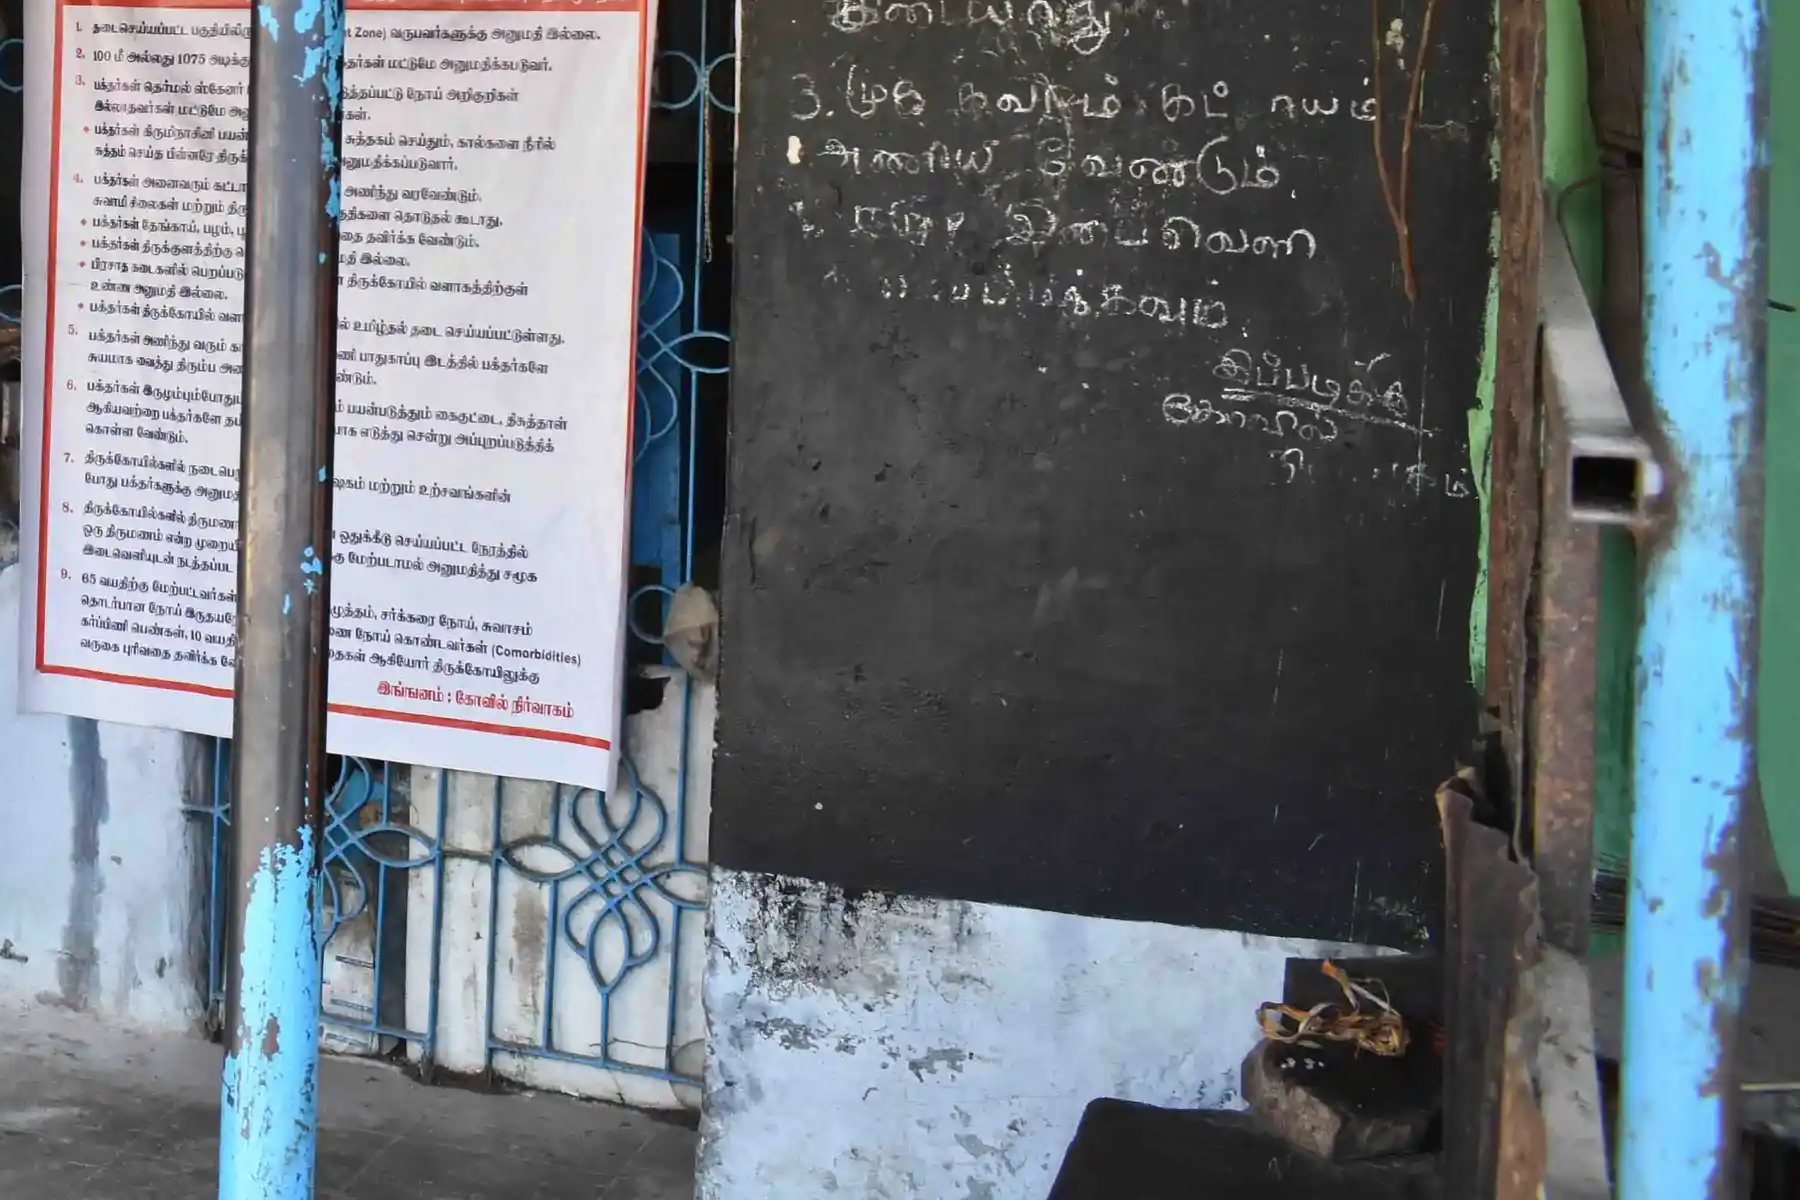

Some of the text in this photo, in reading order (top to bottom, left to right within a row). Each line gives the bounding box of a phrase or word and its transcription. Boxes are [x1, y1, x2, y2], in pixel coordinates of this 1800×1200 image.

[355, 27, 386, 39] Zone)
[491, 27, 543, 42] அனுமதி
[546, 25, 601, 41] இல்லை.
[93, 51, 111, 62] 100
[127, 51, 174, 67] அல்லது
[178, 54, 205, 65] 1075
[82, 573, 96, 584] 65
[190, 630, 201, 642] 10
[456, 689, 509, 710] கோவில்
[512, 695, 574, 719] நிர்வாகம்
